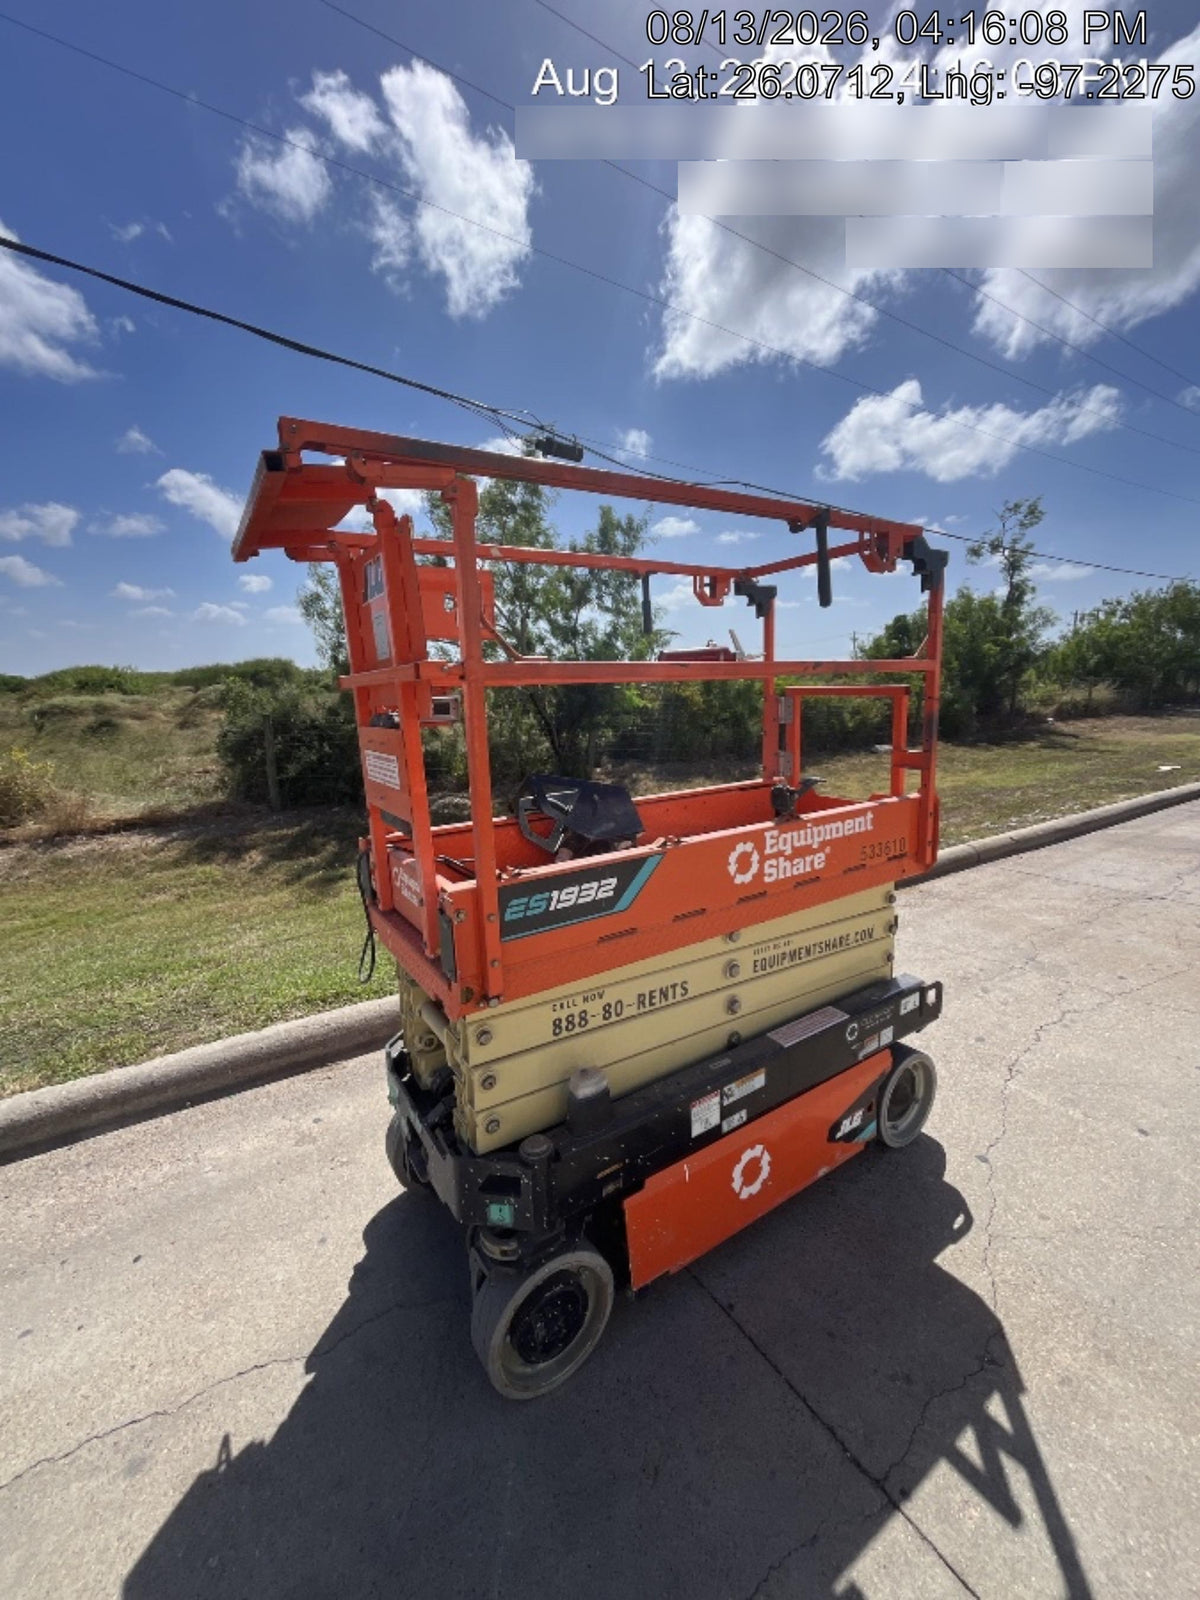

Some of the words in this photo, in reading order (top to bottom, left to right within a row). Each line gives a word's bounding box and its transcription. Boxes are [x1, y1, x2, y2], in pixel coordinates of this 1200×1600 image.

[764, 811, 874, 856] Equipment
[861, 837, 906, 861] 533610
[764, 853, 826, 883] Share
[504, 877, 618, 922] ES1932
[753, 928, 875, 974] EQUIPMENTSHARE.COM
[552, 999, 577, 1012] CALL
[582, 990, 606, 1004] NOW
[552, 980, 690, 1037] 888-80-RENTS
